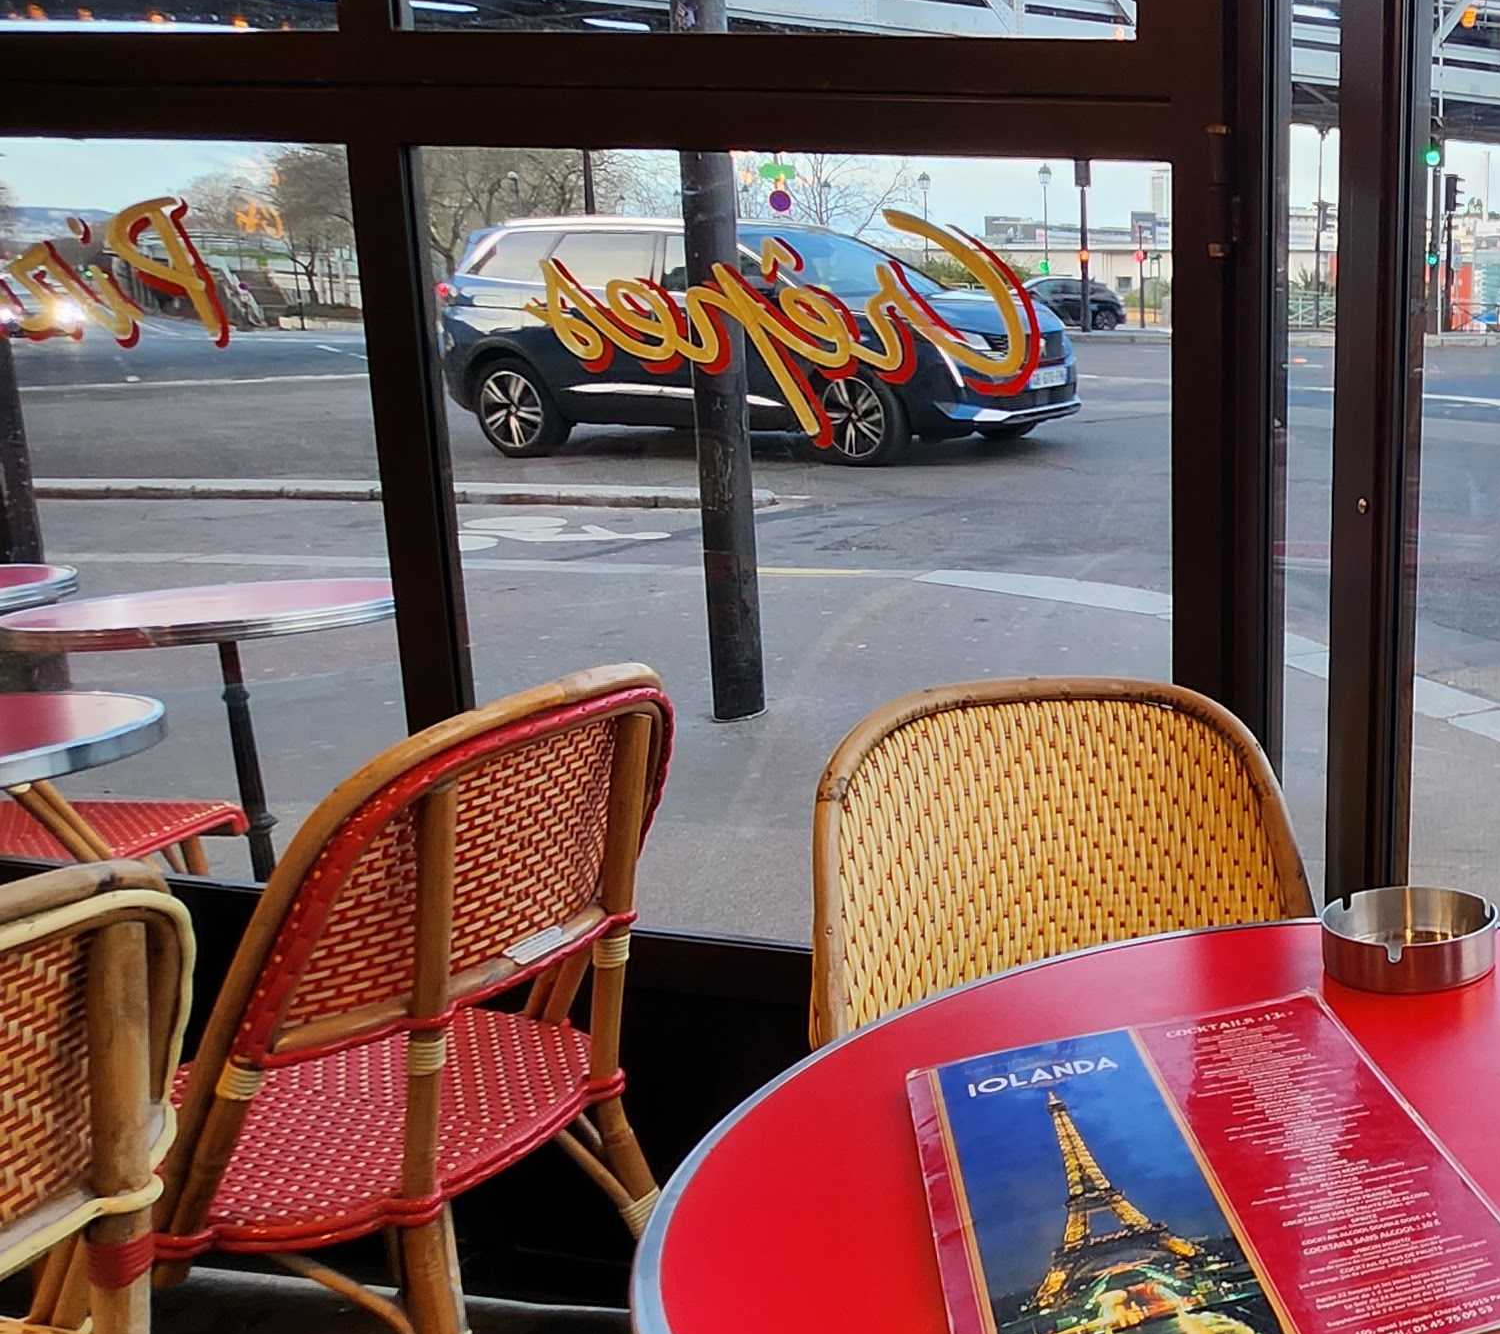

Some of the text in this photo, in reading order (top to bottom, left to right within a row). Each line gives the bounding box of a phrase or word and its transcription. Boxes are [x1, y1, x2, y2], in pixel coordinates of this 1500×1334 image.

[1166, 1017, 1255, 1038] COCKTAILS
[968, 1056, 1118, 1097] IOLANDA
[1303, 1239, 1353, 1256] COCKTAILS
[1353, 1234, 1379, 1245] SANS
[1380, 1225, 1416, 1239] ALCOOL
[1376, 1322, 1398, 1333] quai
[1398, 1313, 1433, 1327] Jacques
[1434, 1305, 1462, 1317] Chirac
[1462, 1297, 1490, 1309] 75015
[1413, 1323, 1429, 1333] 01
[1430, 1319, 1445, 1328] 45
[1445, 1314, 1461, 1324] 75
[1461, 1310, 1477, 1319] 09
[1478, 1305, 1493, 1314] 53
